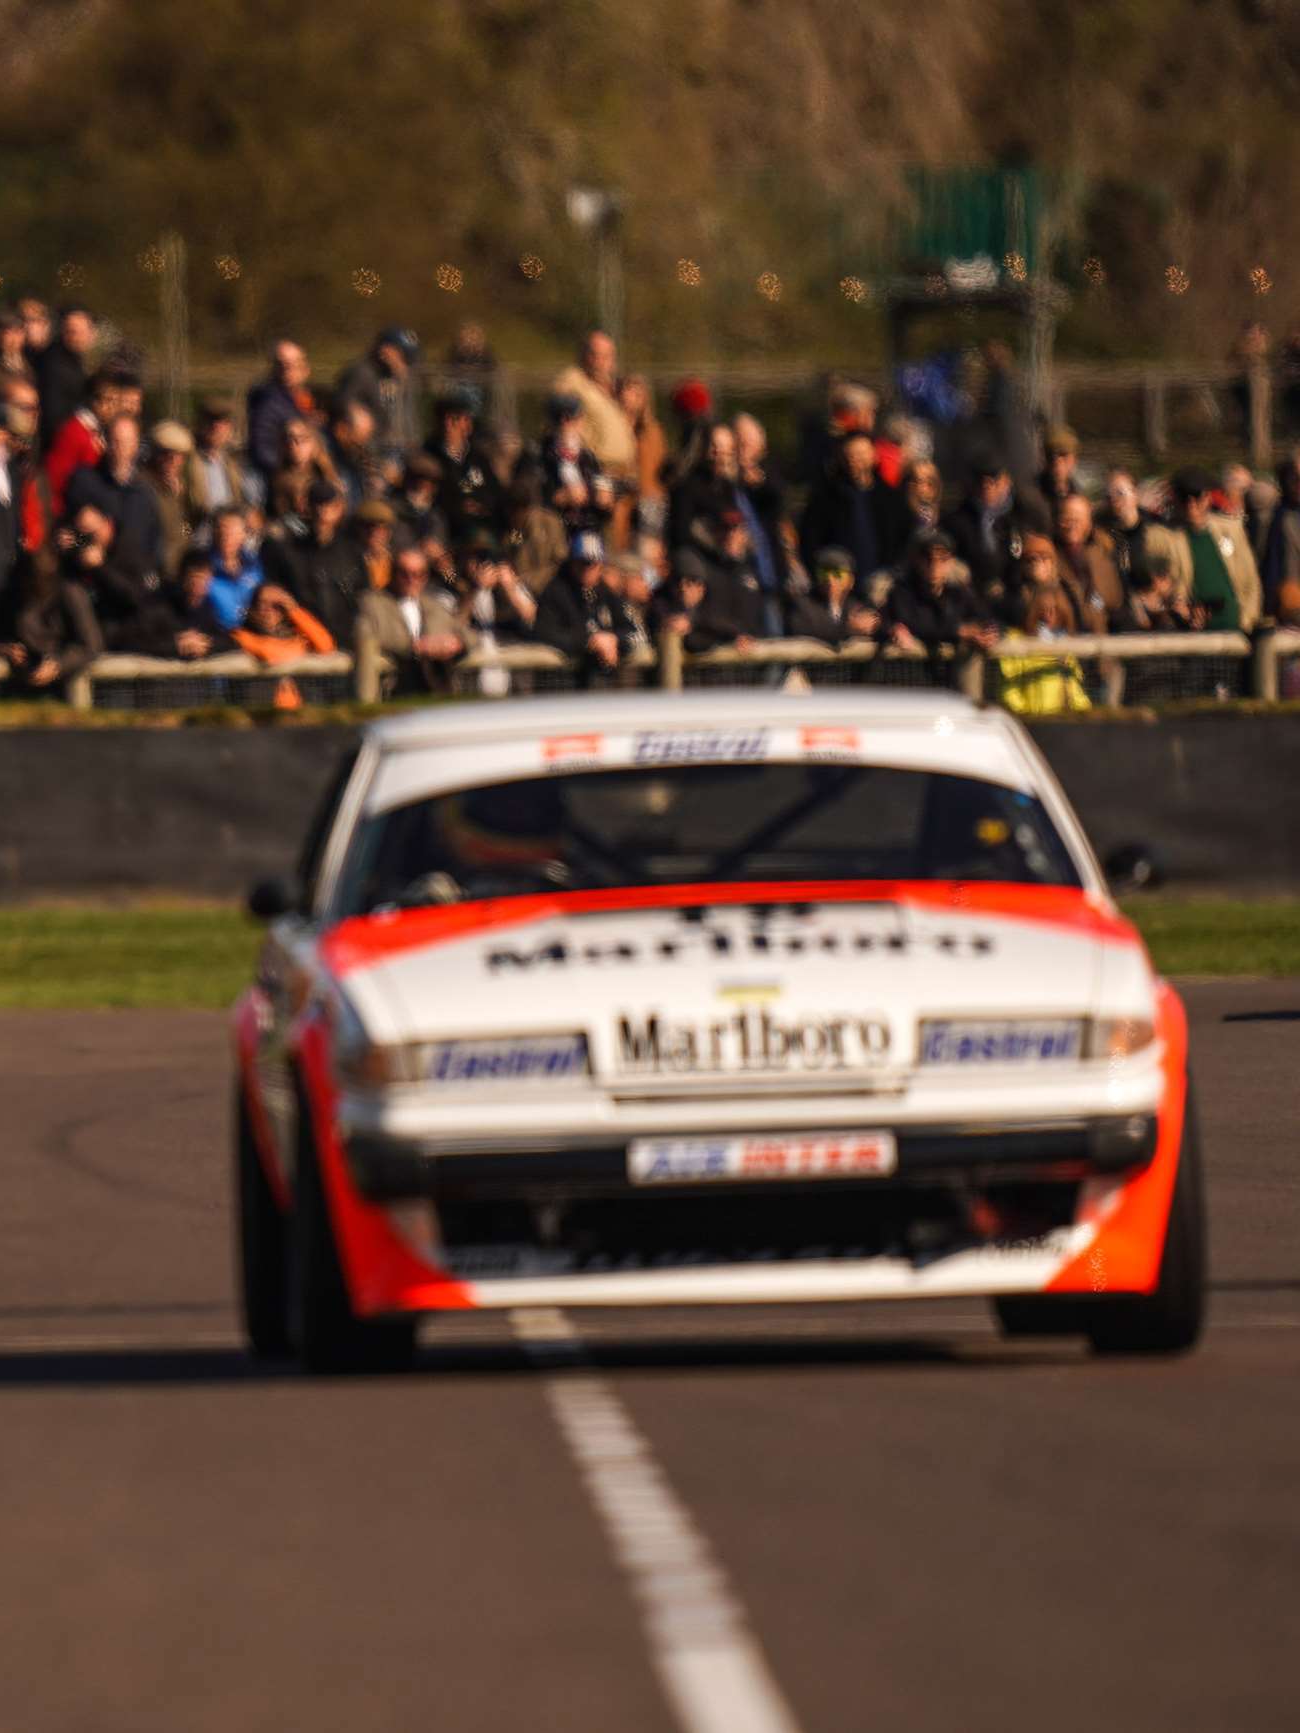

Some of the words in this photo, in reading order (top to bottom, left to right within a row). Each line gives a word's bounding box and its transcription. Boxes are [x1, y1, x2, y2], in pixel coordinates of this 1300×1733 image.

[431, 1034, 586, 1079] Castrol
[617, 1008, 892, 1073] Marlboro
[921, 1018, 1078, 1061] Castrol
